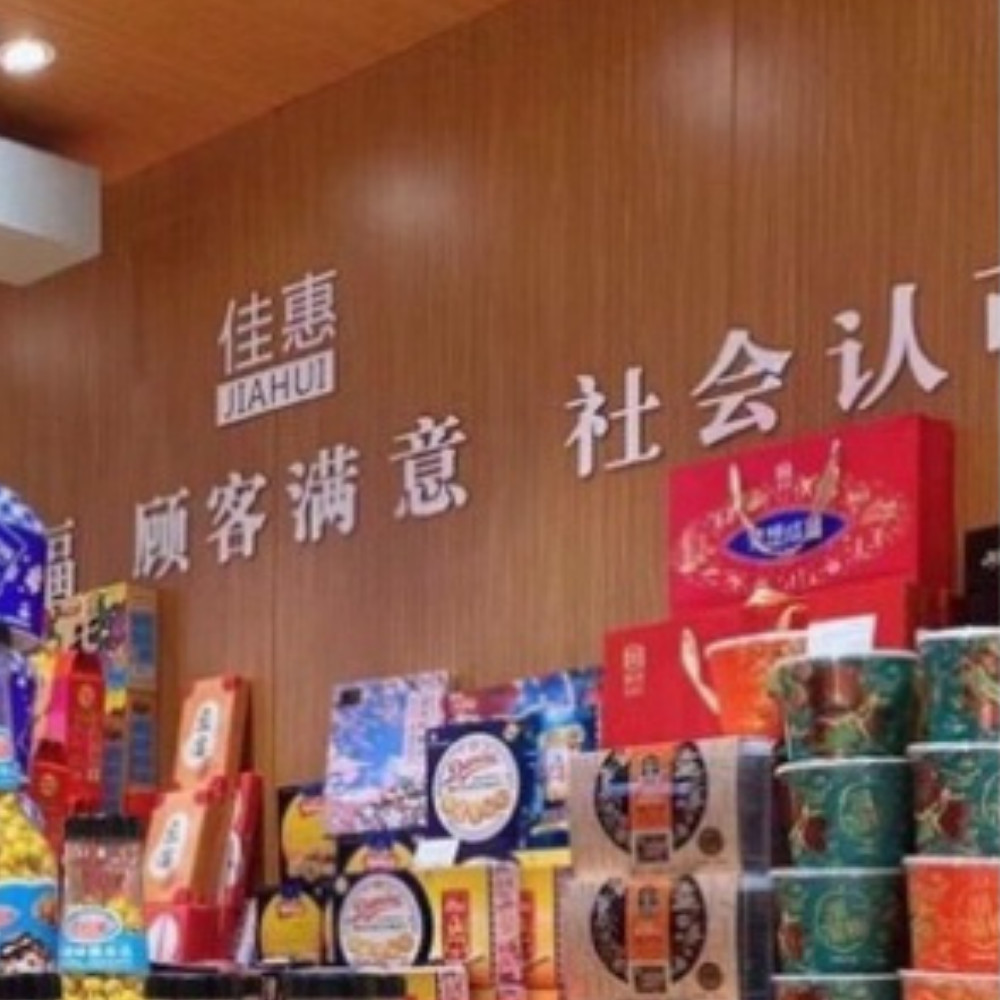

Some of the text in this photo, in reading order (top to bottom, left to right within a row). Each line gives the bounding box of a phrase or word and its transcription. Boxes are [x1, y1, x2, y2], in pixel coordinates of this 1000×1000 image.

[217, 269, 338, 376] 佳惠
[131, 414, 469, 581] 顾客满意
[564, 264, 998, 478] 社会认
[222, 354, 327, 421] JIAHUI
